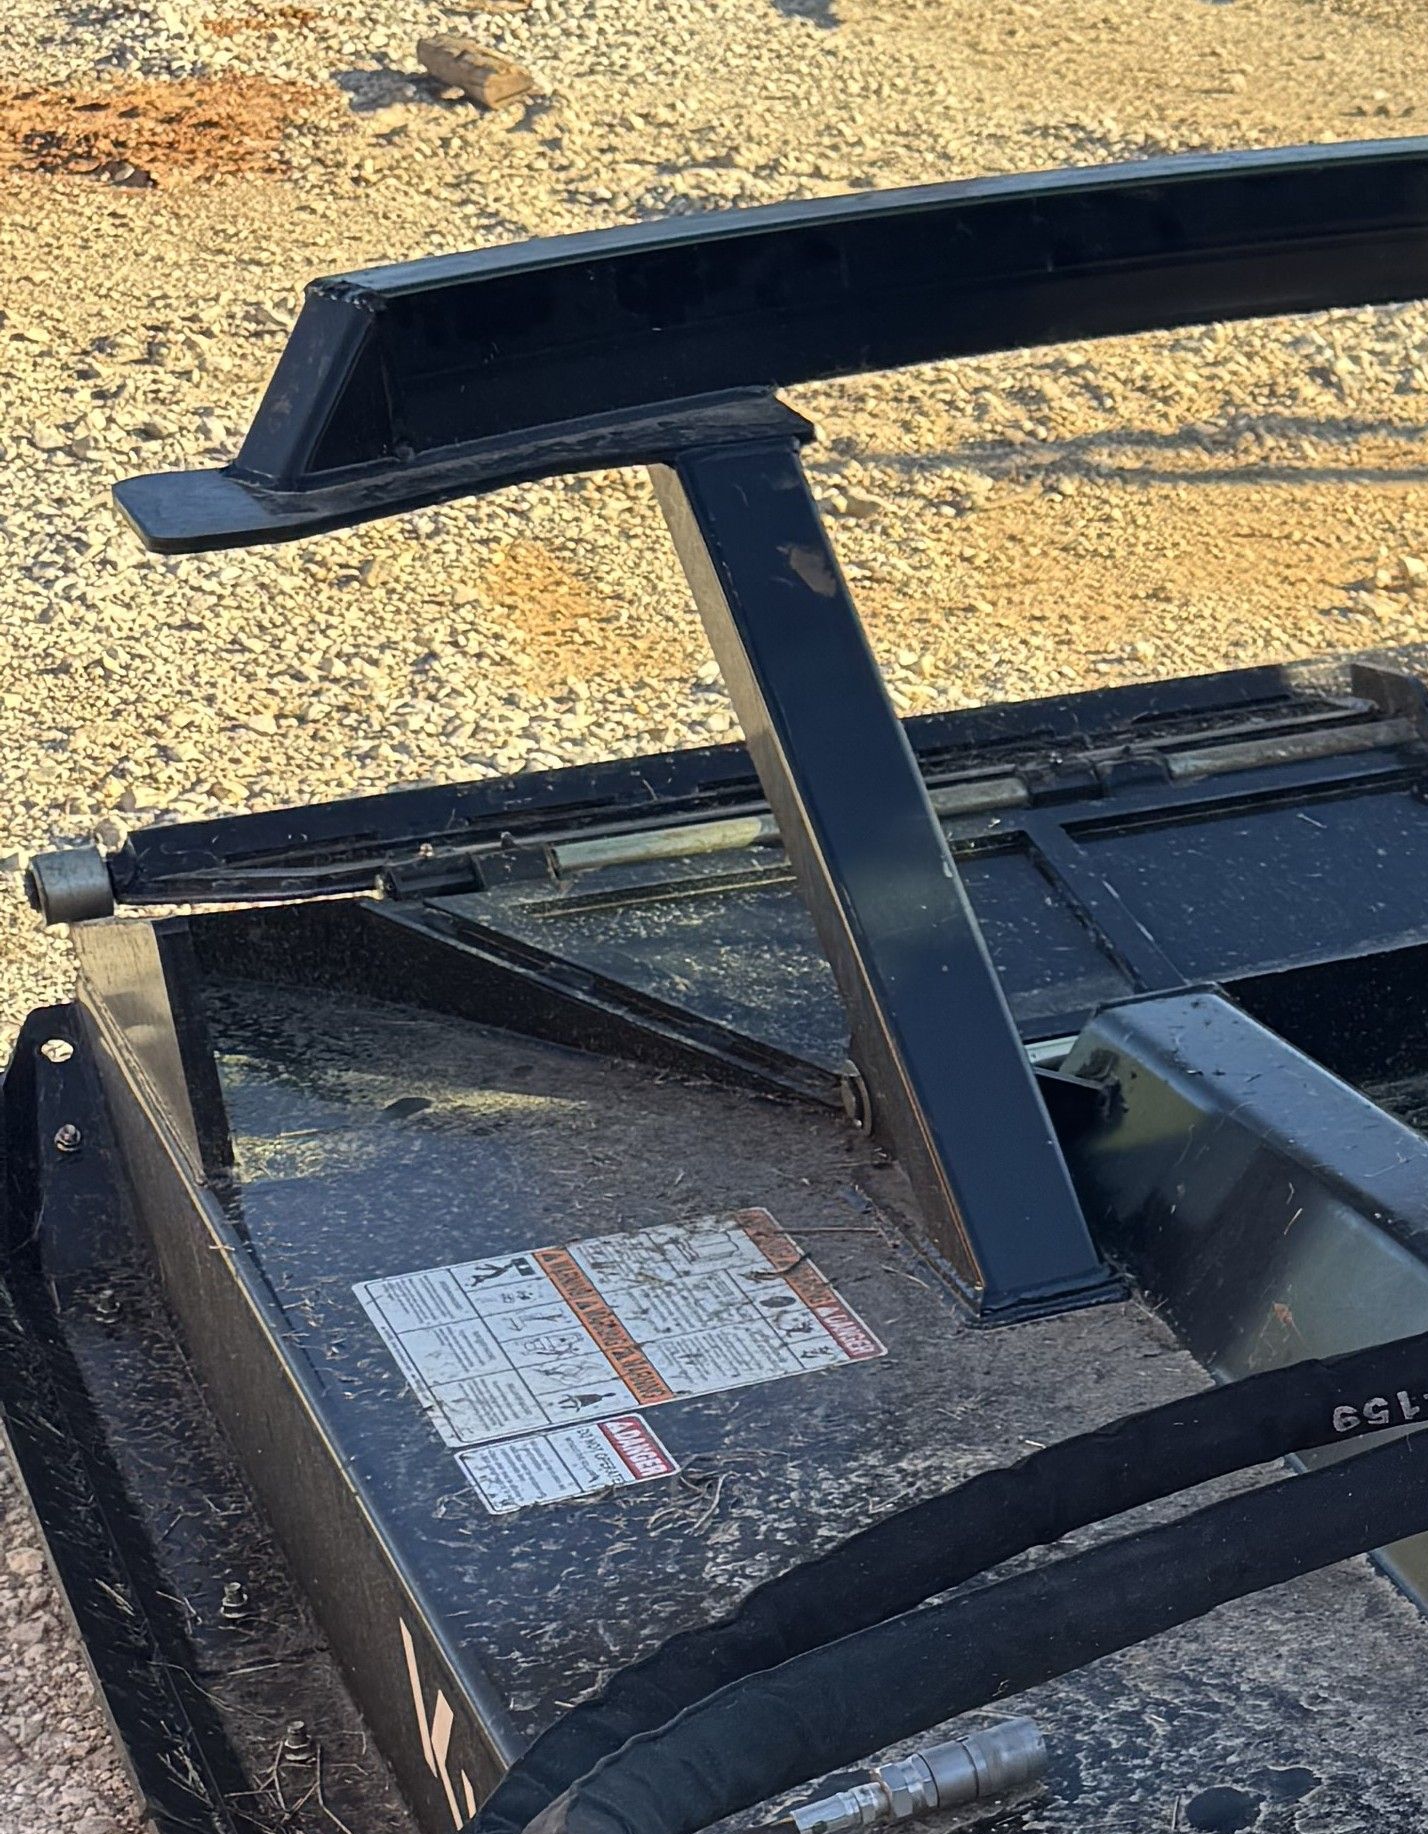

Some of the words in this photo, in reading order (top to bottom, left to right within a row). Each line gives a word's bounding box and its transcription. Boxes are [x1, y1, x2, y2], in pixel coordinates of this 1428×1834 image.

[823, 1314, 876, 1351] DANGER
[622, 1359, 667, 1399] WARNING
[612, 1429, 669, 1477] DANGER
